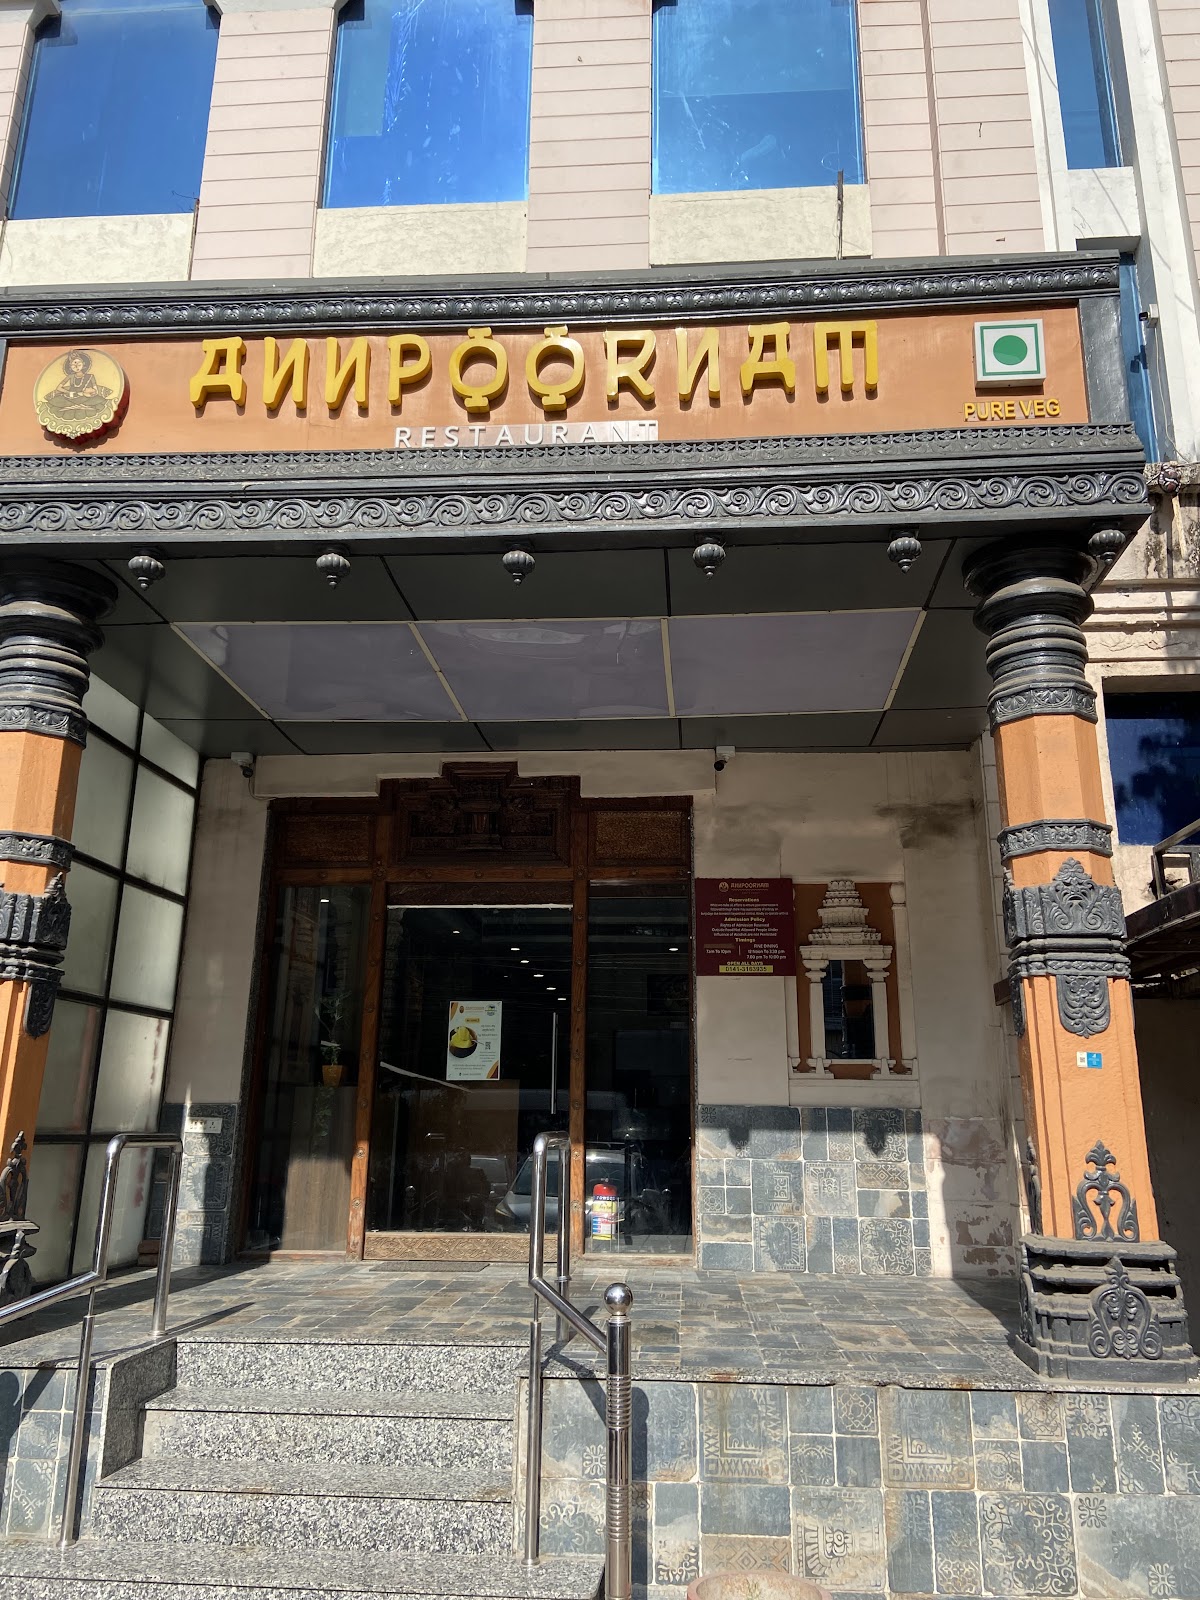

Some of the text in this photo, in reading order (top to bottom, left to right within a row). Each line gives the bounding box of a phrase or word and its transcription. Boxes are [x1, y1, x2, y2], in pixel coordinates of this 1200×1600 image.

[964, 398, 1060, 421] PURE VEG
[394, 422, 657, 449] RESTAURANT
